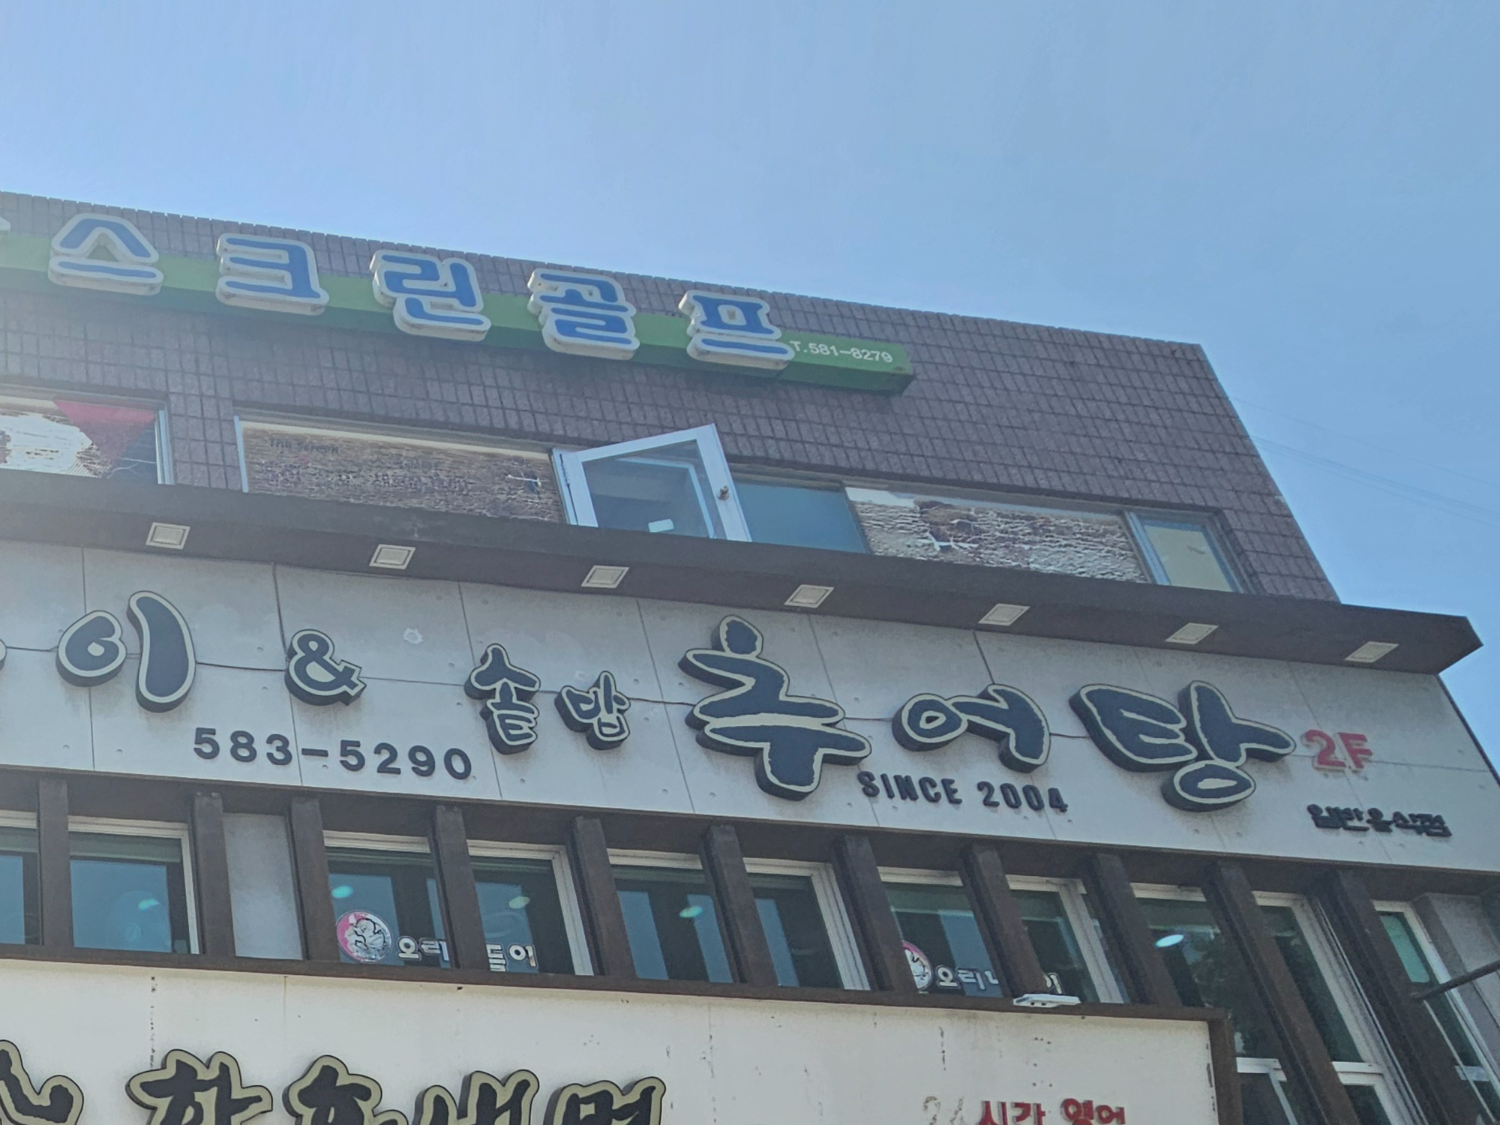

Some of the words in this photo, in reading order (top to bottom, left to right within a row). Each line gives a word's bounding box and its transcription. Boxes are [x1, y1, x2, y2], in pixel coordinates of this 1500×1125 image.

[48, 212, 796, 370] 스크린골프
[789, 340, 893, 363] T.581-8279
[286, 629, 366, 706] &
[678, 614, 1296, 812] 추어탕
[193, 727, 473, 782] 583-5290
[1303, 729, 1373, 772] 2F
[857, 770, 963, 805] SINCE
[977, 780, 1069, 813] 2004
